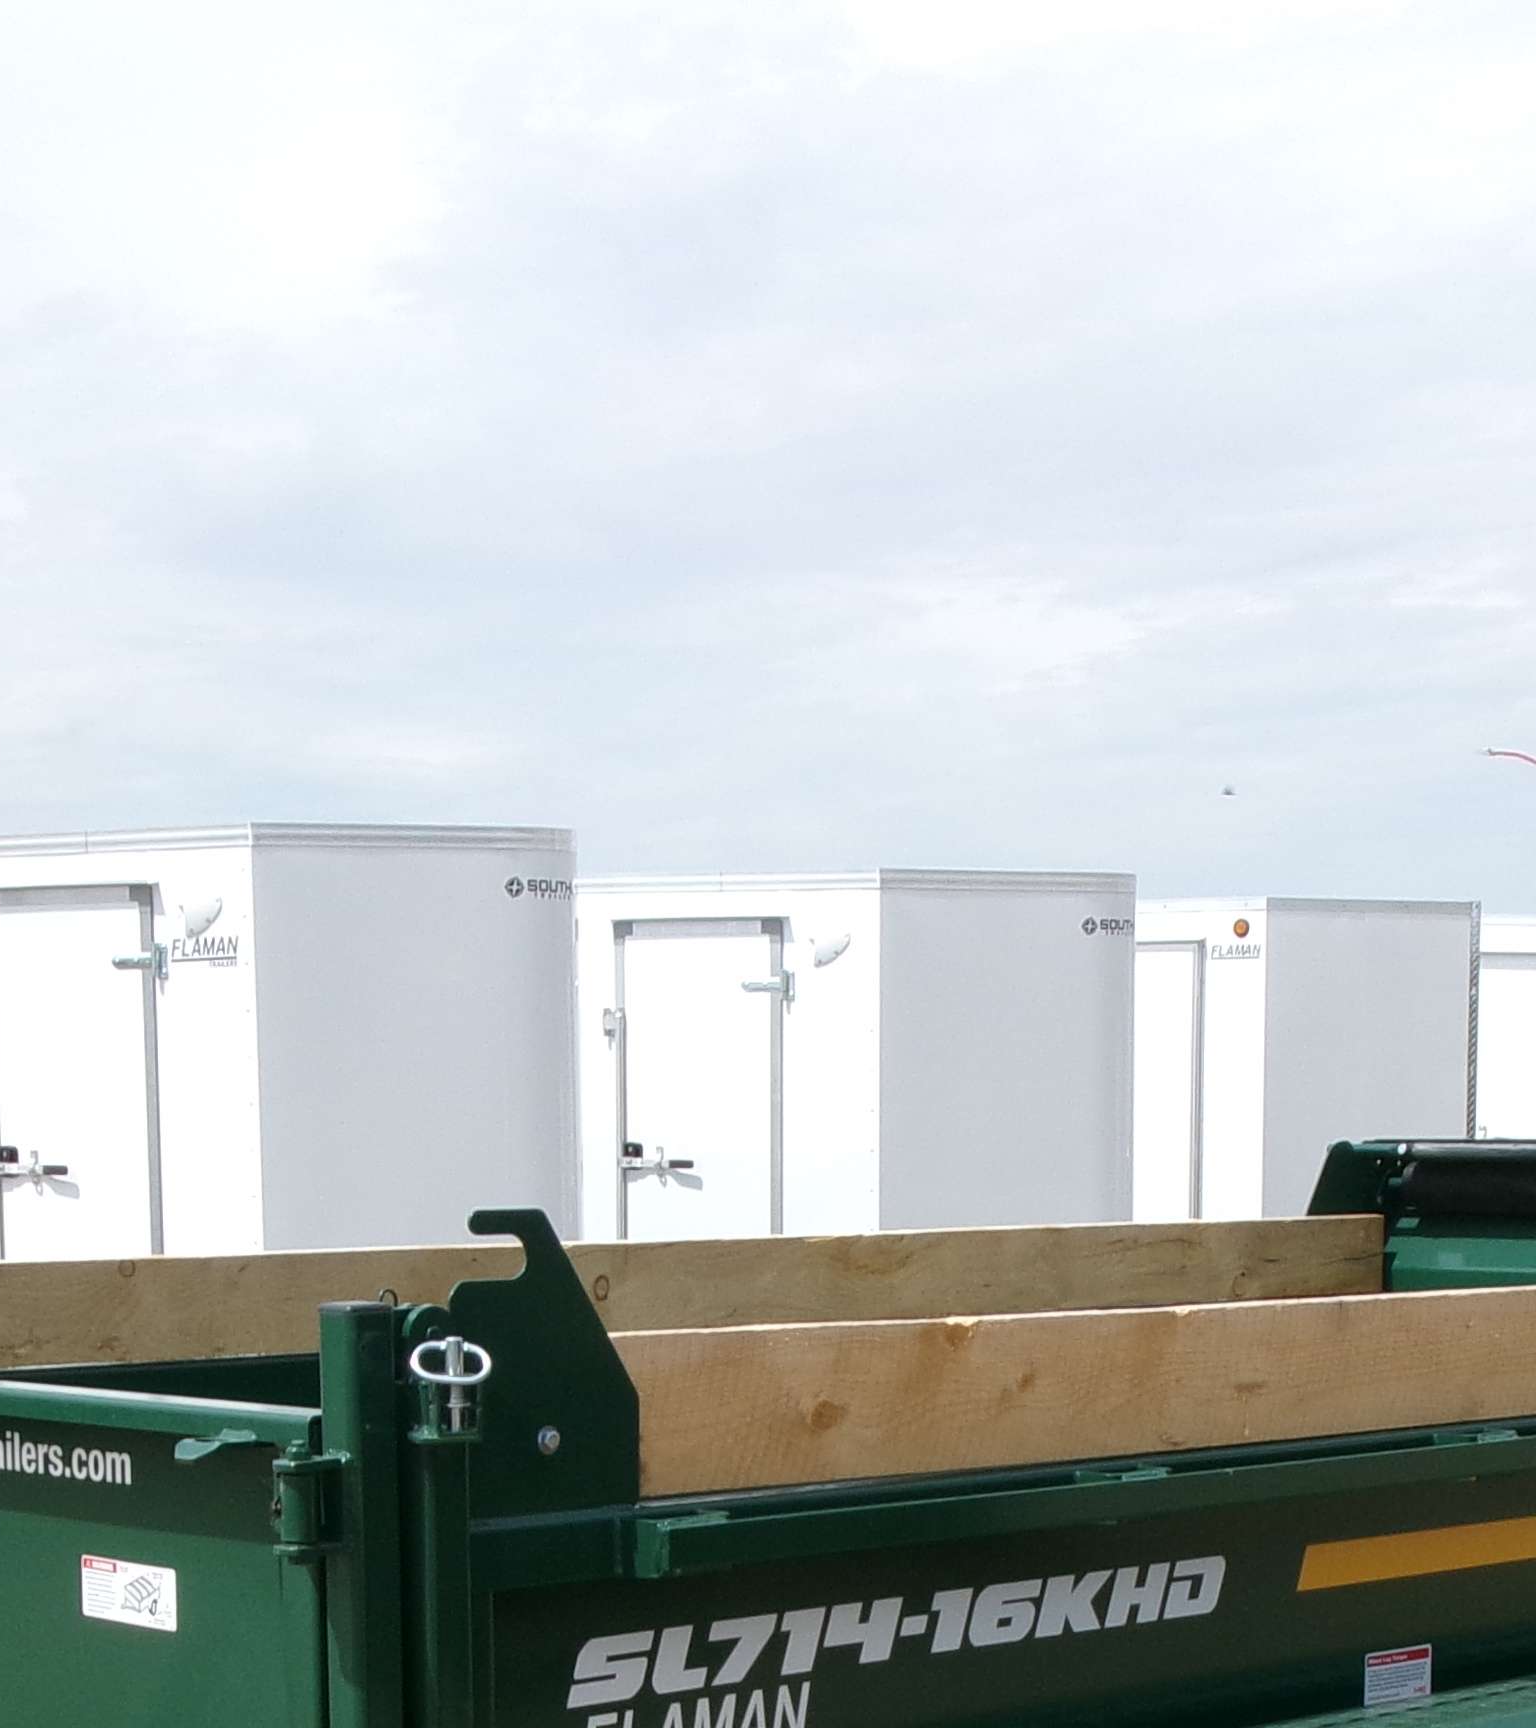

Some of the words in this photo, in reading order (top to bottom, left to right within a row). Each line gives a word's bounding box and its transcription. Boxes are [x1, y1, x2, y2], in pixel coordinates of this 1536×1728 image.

[171, 935, 239, 958] FLAMAN
[1211, 944, 1261, 957] FLAMAN
[567, 1554, 1228, 1709] SL714-16KHD
